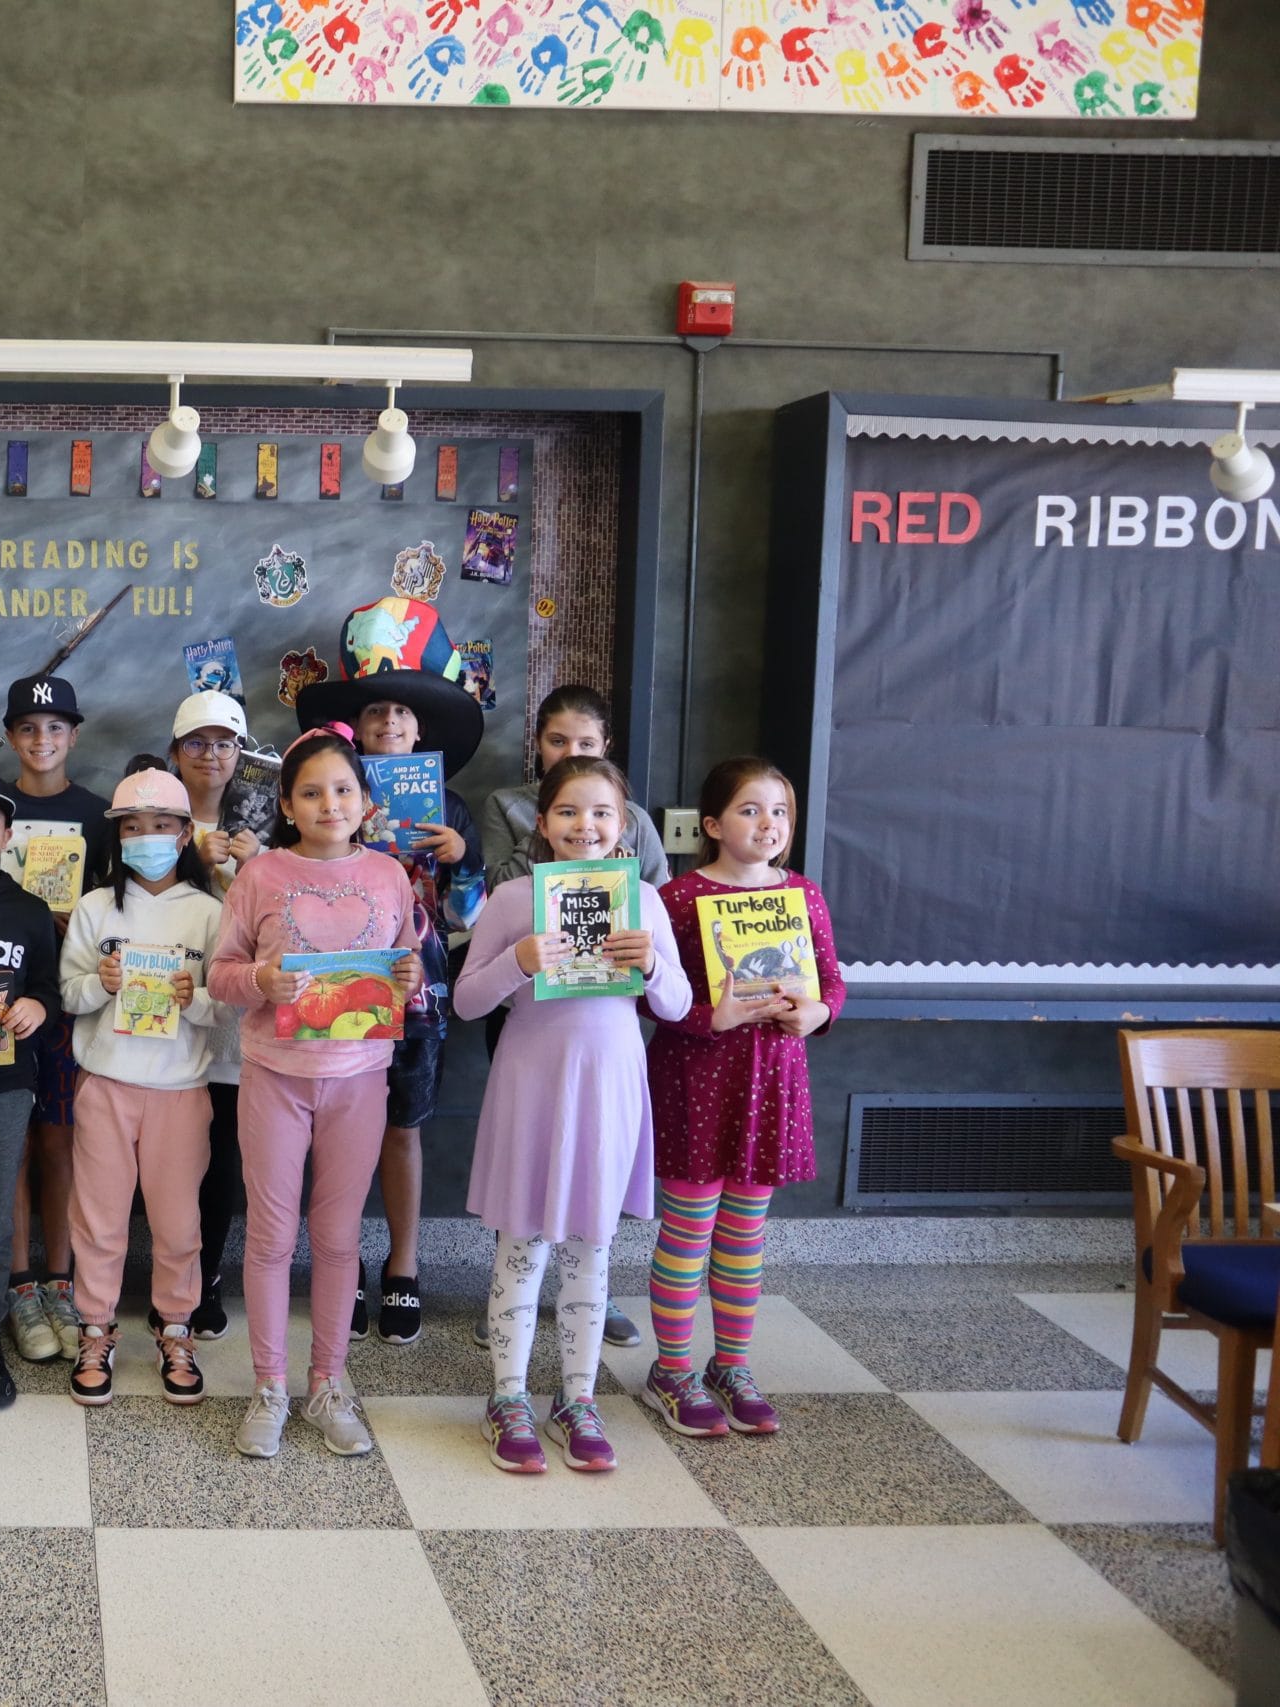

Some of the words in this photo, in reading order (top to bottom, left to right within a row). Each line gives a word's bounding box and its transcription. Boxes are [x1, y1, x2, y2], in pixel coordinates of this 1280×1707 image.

[470, 511, 493, 527] Harry
[493, 511, 518, 528] Potter
[851, 492, 982, 544] RED
[0, 540, 149, 569] READING
[173, 540, 199, 569] IS
[133, 586, 193, 616] FUL!
[186, 645, 208, 662] Harry
[208, 640, 233, 655] Potter
[468, 639, 492, 654] Potter
[393, 766, 408, 774] AND
[409, 765, 420, 773] MY
[393, 781, 438, 795] SPACE
[566, 896, 600, 910] MISS
[713, 896, 786, 915] Turkey
[561, 910, 611, 925] NELSON
[732, 914, 804, 935] Trouble
[577, 926, 588, 937] IS
[124, 950, 148, 969] JUDY
[149, 953, 182, 972] BLUME
